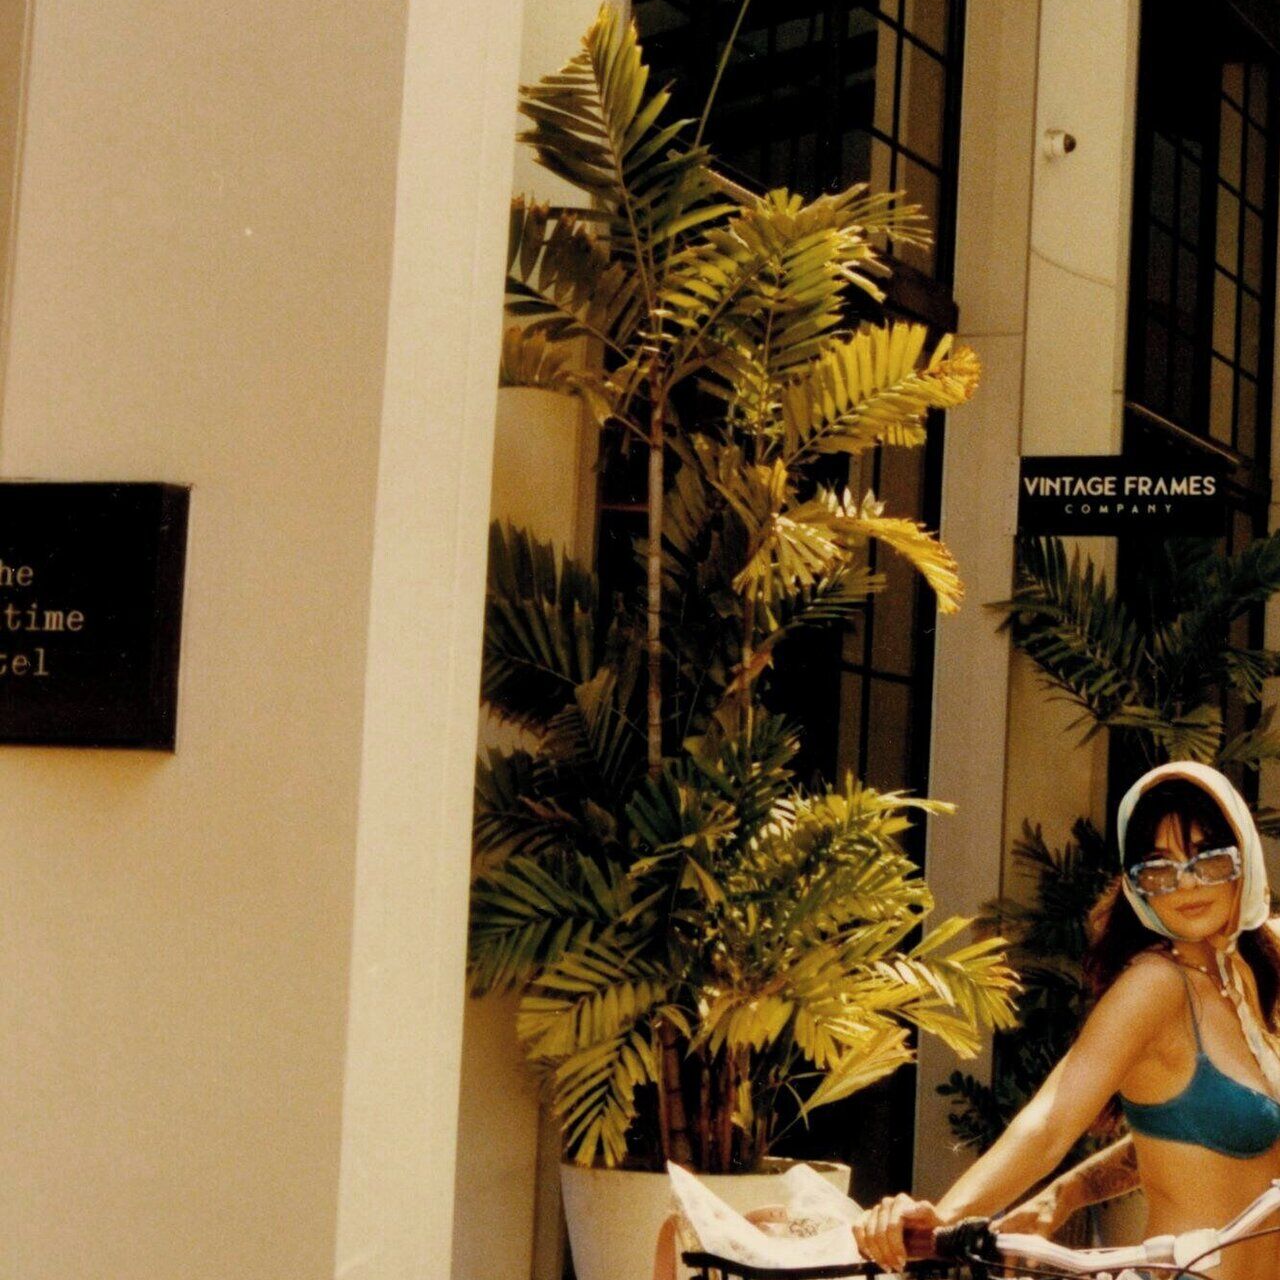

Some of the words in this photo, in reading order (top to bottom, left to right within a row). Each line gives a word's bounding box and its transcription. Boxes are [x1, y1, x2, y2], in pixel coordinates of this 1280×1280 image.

[1024, 476, 1117, 496] VINTAGE
[1124, 476, 1216, 496] FRAMES
[1065, 504, 1172, 514] COMPANY
